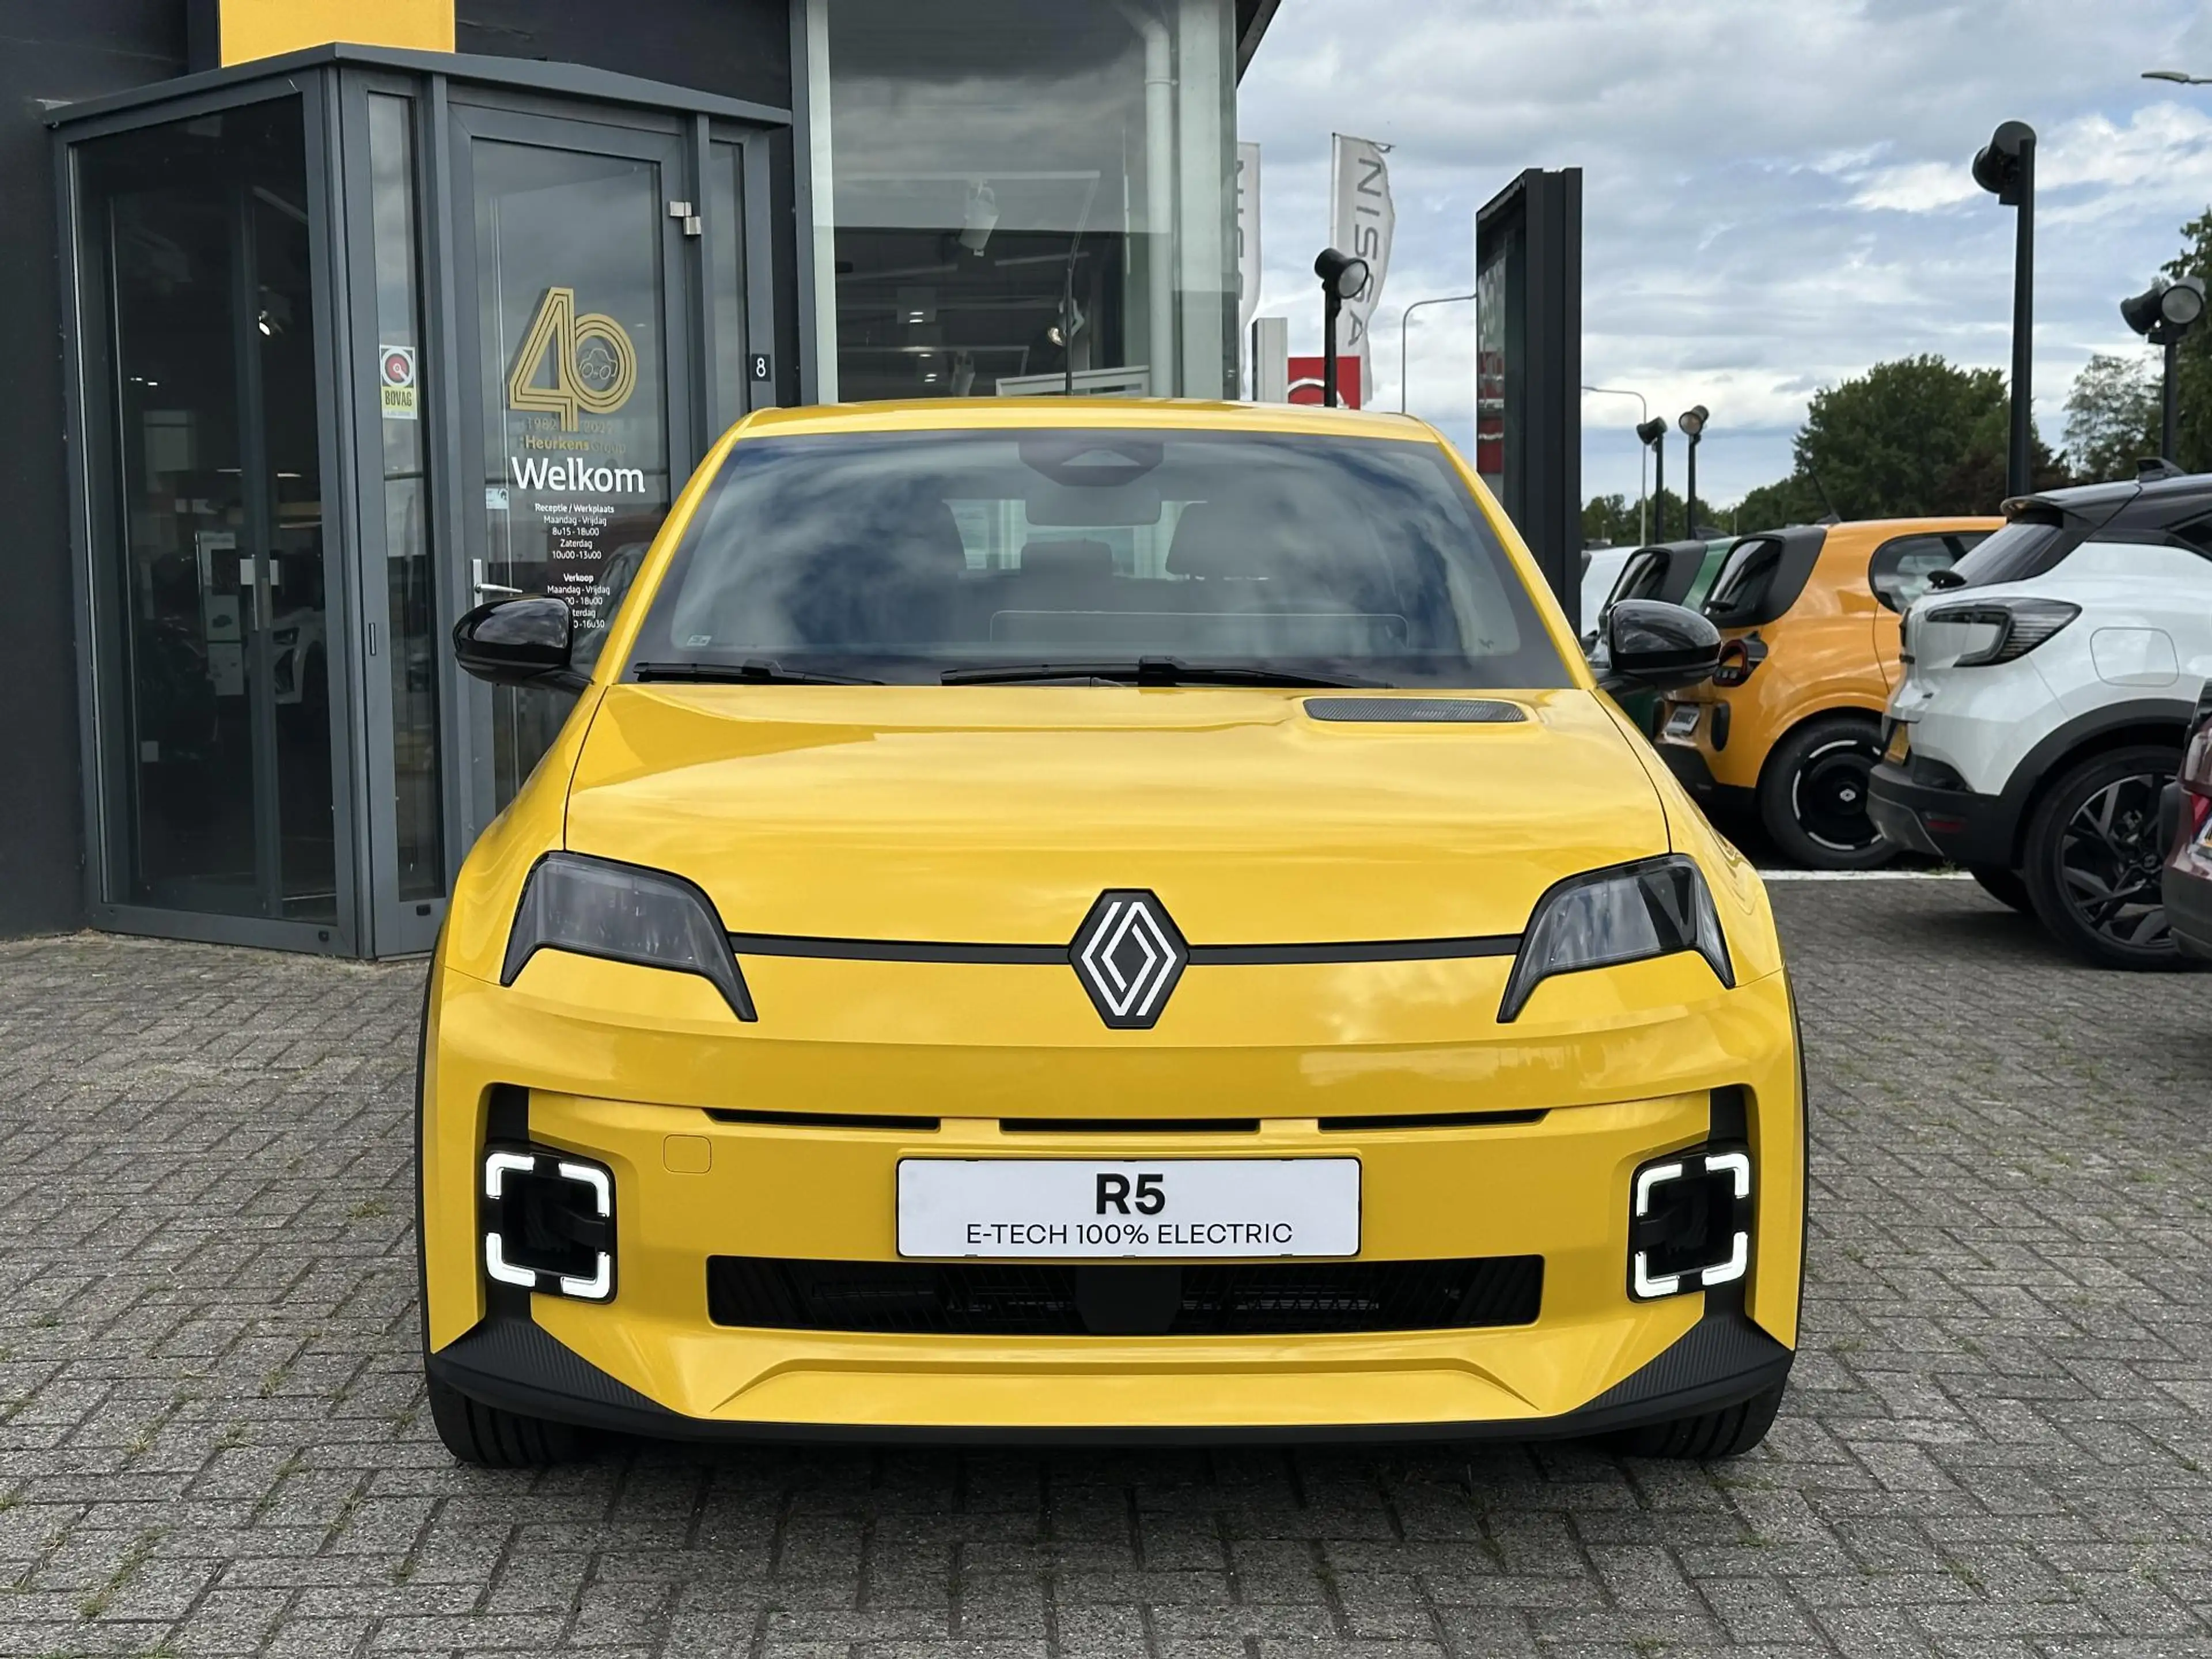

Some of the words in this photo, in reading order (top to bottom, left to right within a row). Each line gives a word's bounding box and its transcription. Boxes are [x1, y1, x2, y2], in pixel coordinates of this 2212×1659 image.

[509, 286, 637, 432] 40
[756, 357, 766, 377] 8
[385, 390, 412, 407] BOVAG
[525, 435, 589, 452] Heurkens
[511, 457, 646, 493] Welkom
[534, 502, 567, 514] Receptie
[573, 503, 615, 515] Werkplaats
[543, 515, 577, 526] Maandag
[582, 516, 607, 527] Vrijdag
[552, 527, 571, 536] 8u15
[577, 527, 599, 536] 18u00
[560, 539, 593, 550] Zaterdag
[552, 550, 575, 559] 10u00
[579, 551, 601, 559] 13u00
[563, 573, 594, 584] Verkoop
[547, 585, 581, 596] Maandag
[585, 585, 610, 596] Vrijdag
[1095, 1172, 1166, 1215] R5
[966, 1224, 1067, 1244] E-TECH
[1075, 1224, 1149, 1244] 100%
[1157, 1224, 1293, 1244] ELECTRIC
